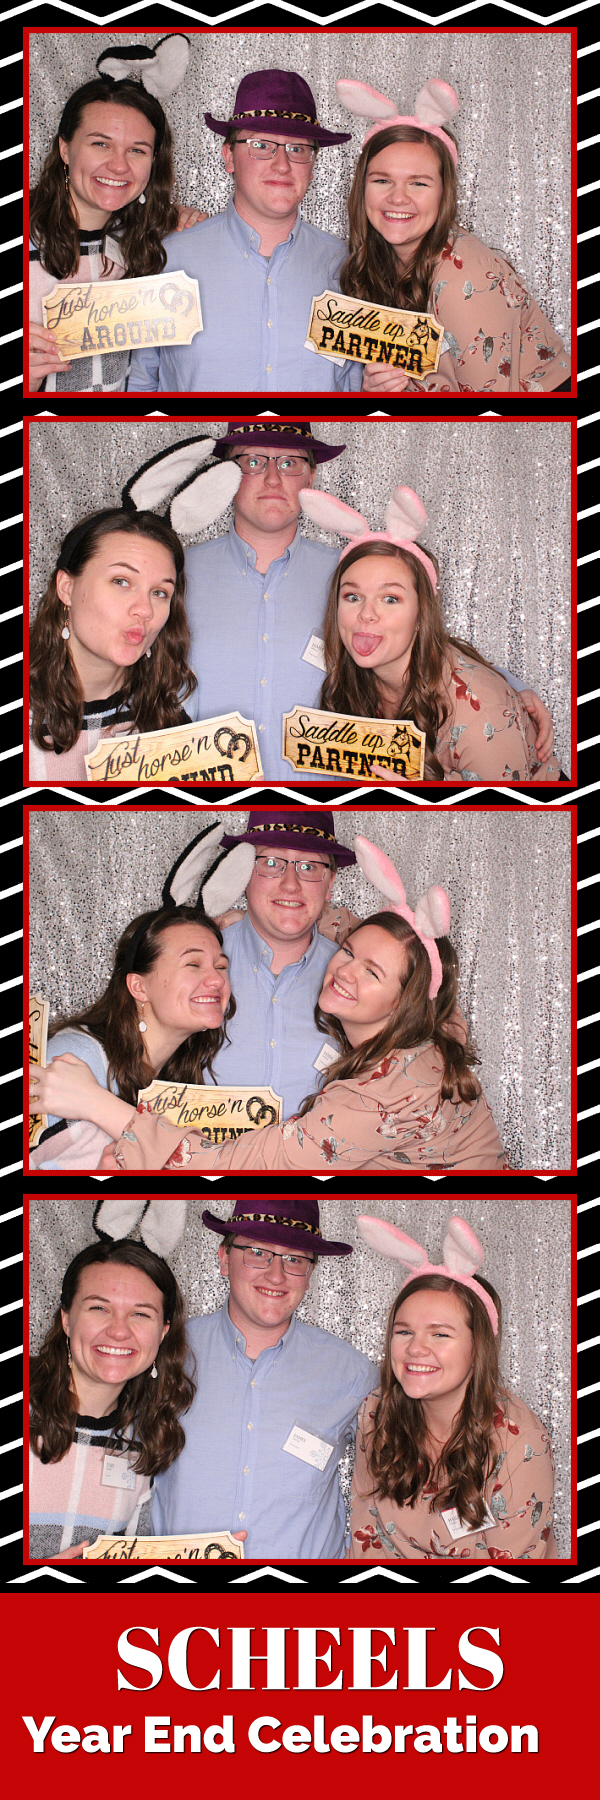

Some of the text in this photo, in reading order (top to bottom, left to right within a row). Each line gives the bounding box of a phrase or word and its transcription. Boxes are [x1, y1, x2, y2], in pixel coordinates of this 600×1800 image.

[44, 284, 157, 329] Just horse'n
[317, 299, 405, 341] Saddle up
[80, 317, 176, 351] AROUND
[319, 326, 422, 373] PARTNER
[290, 715, 385, 753] Saddle up
[88, 735, 211, 781] Just horse'n
[177, 1098, 244, 1124] horse'n
